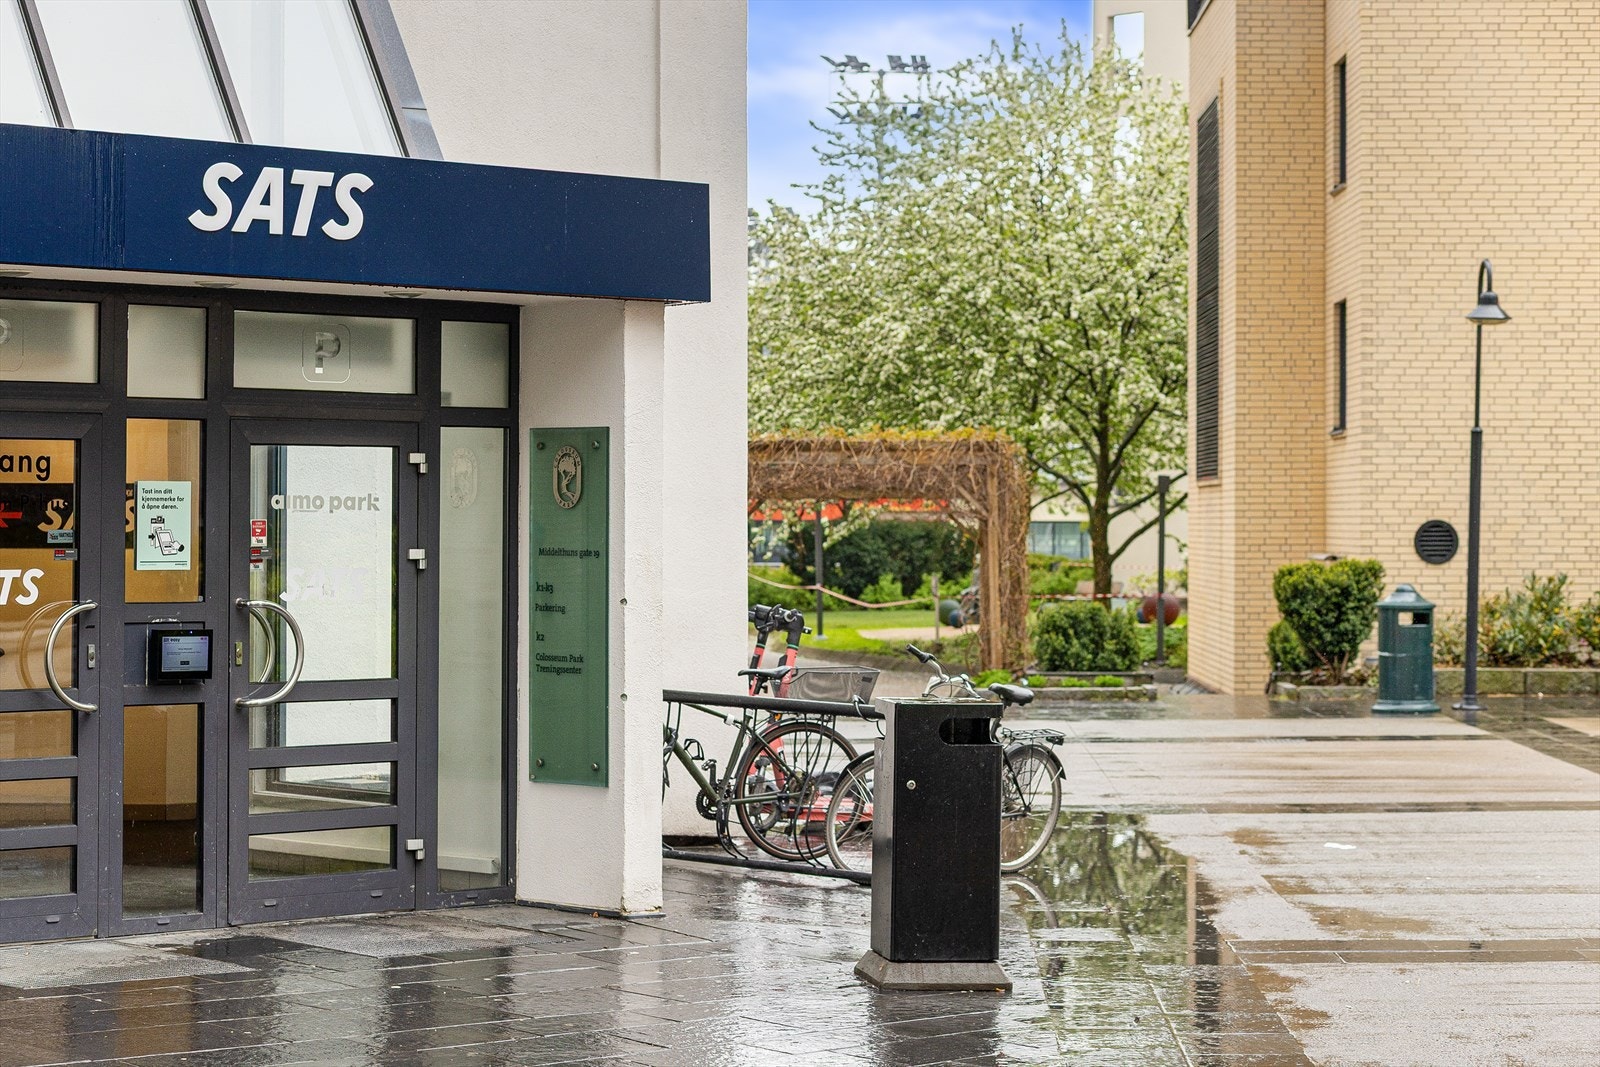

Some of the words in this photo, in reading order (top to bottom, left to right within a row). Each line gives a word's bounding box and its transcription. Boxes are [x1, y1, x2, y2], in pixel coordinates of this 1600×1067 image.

[188, 162, 374, 241] SATS
[0, 454, 51, 482] ang
[329, 493, 380, 514] park
[538, 547, 578, 557] Middelthuns
[578, 548, 592, 559] gate
[593, 550, 599, 558] 19
[534, 602, 566, 615] Parkering
[535, 631, 545, 641] k2
[535, 652, 568, 662] Colosseum
[569, 654, 584, 663] Park
[535, 663, 582, 676] Treningssenter
